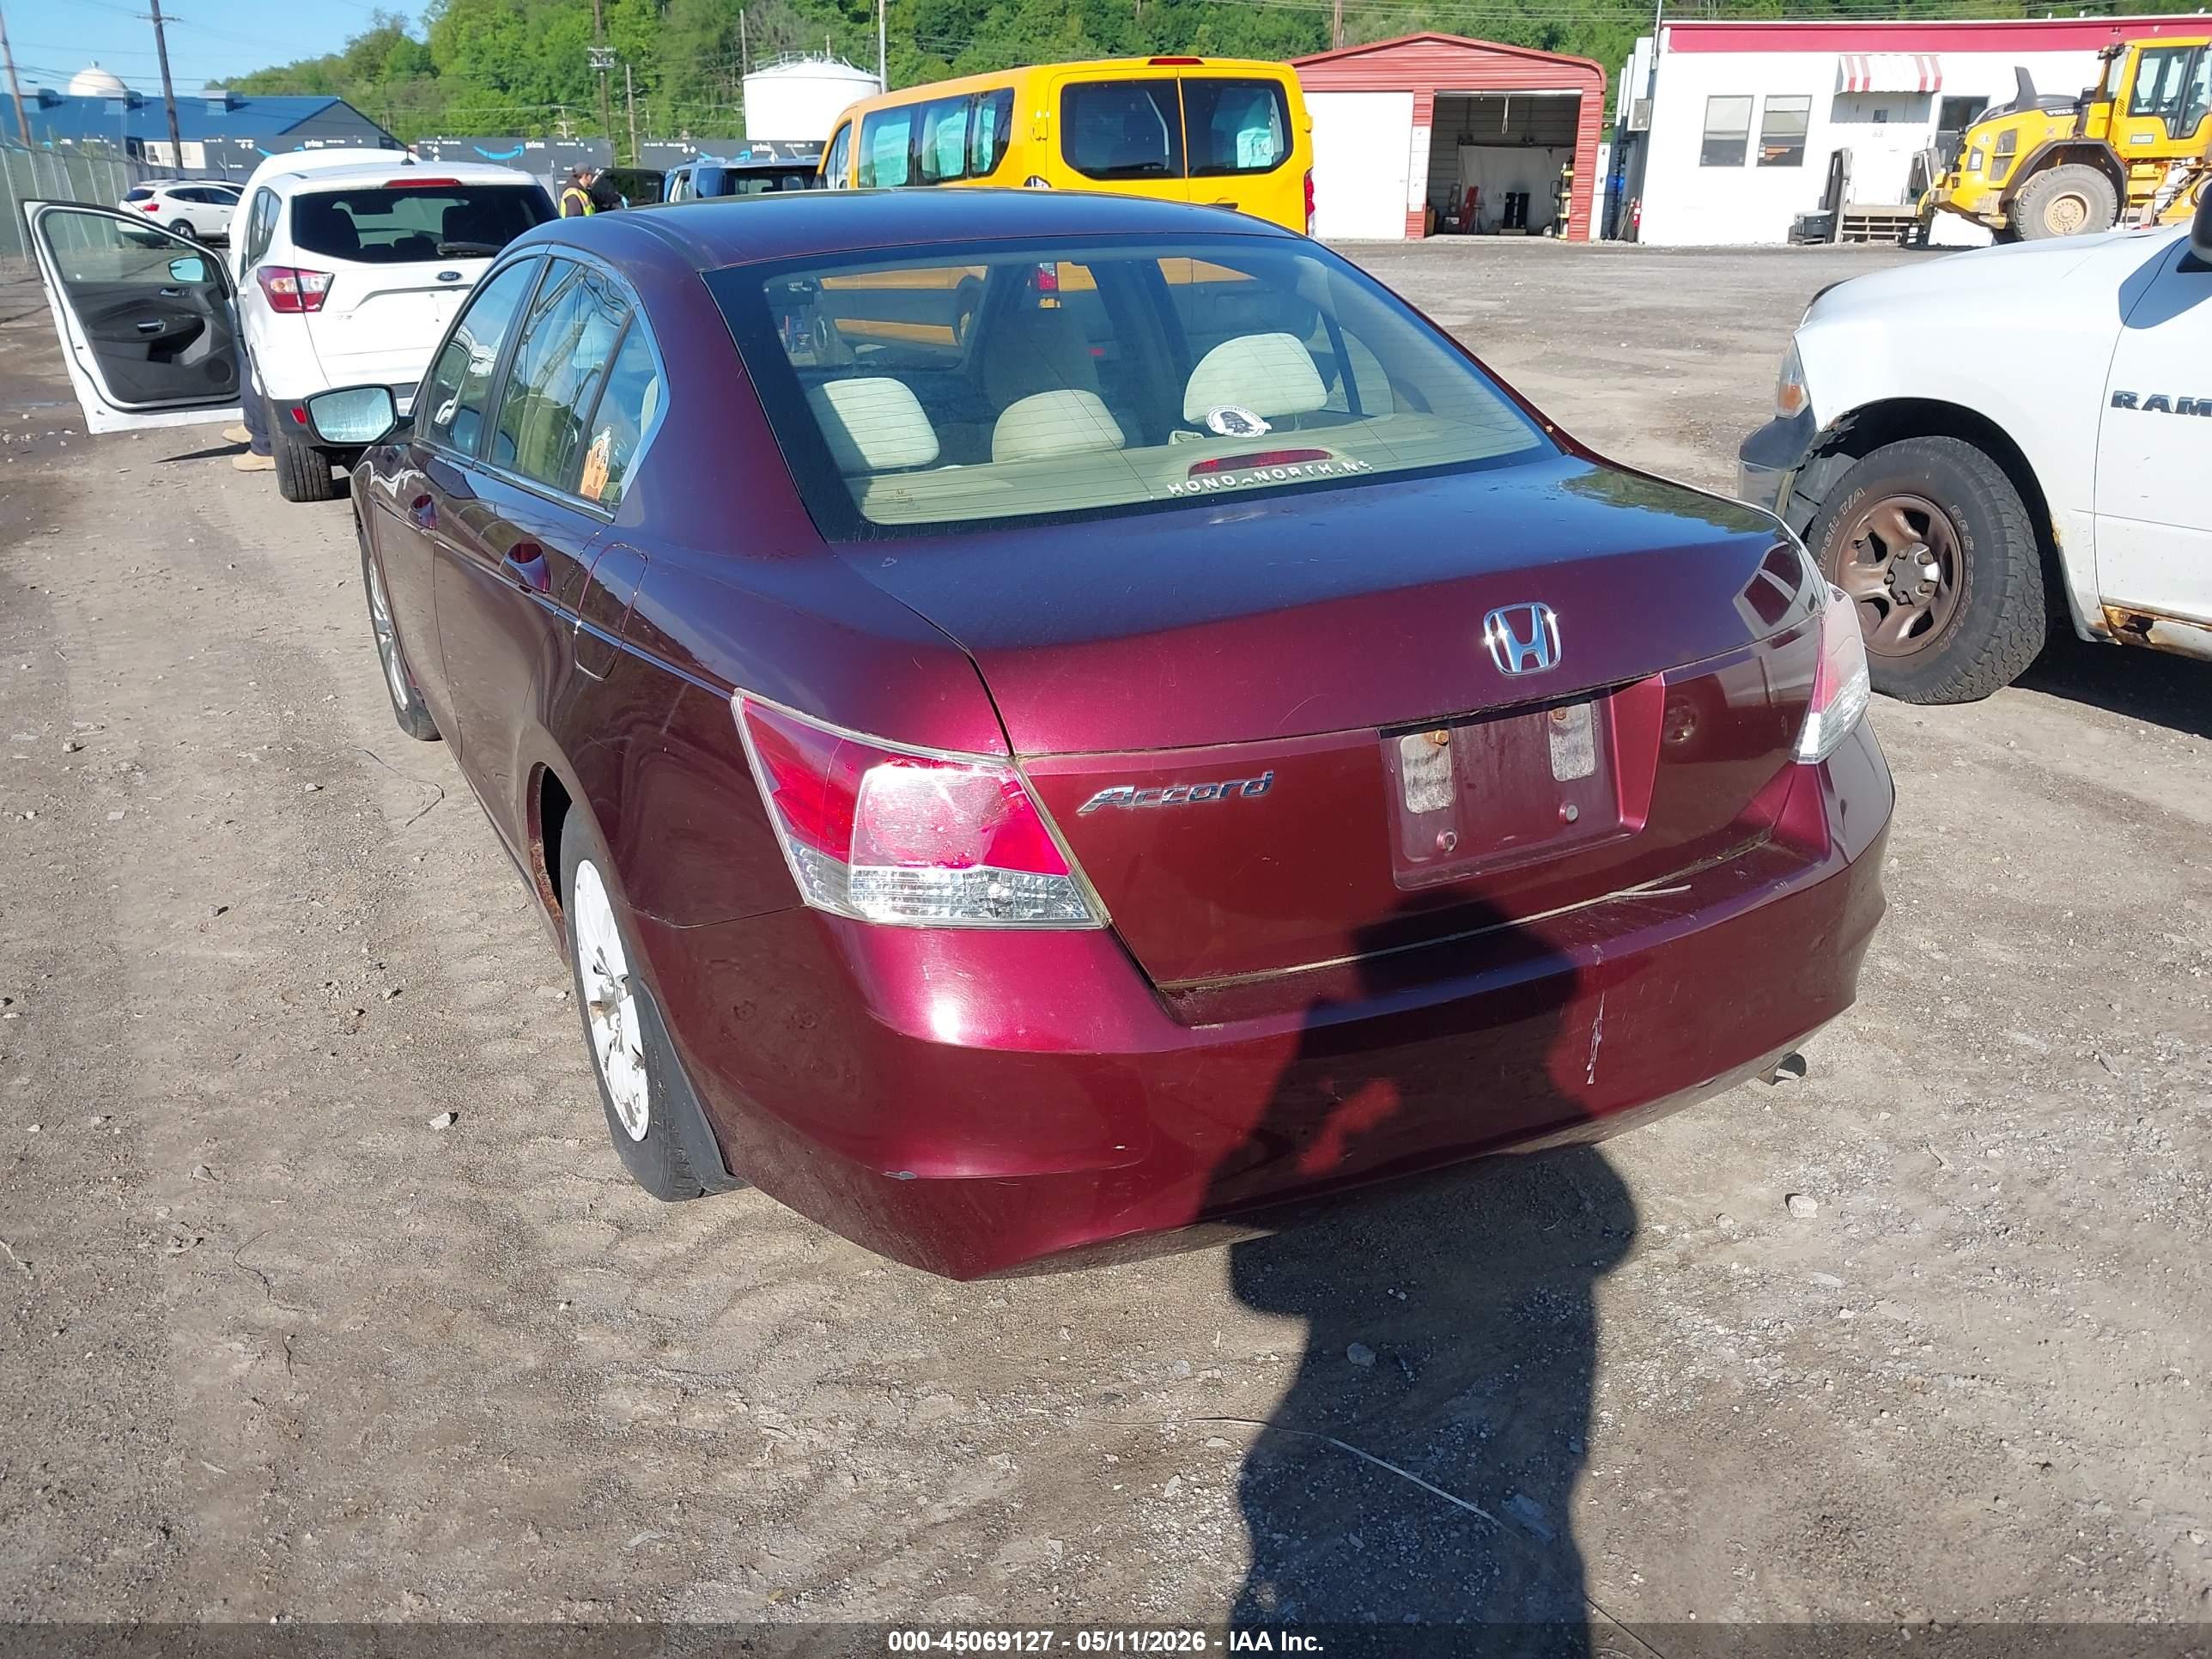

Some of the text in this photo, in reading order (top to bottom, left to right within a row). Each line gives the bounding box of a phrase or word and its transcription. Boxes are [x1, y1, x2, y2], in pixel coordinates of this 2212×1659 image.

[304, 139, 324, 149] prime
[525, 140, 544, 149] prime
[751, 142, 772, 153] prim
[2111, 390, 2212, 417] RAM
[1840, 487, 1865, 516] T/A
[1076, 769, 1275, 815] Accord
